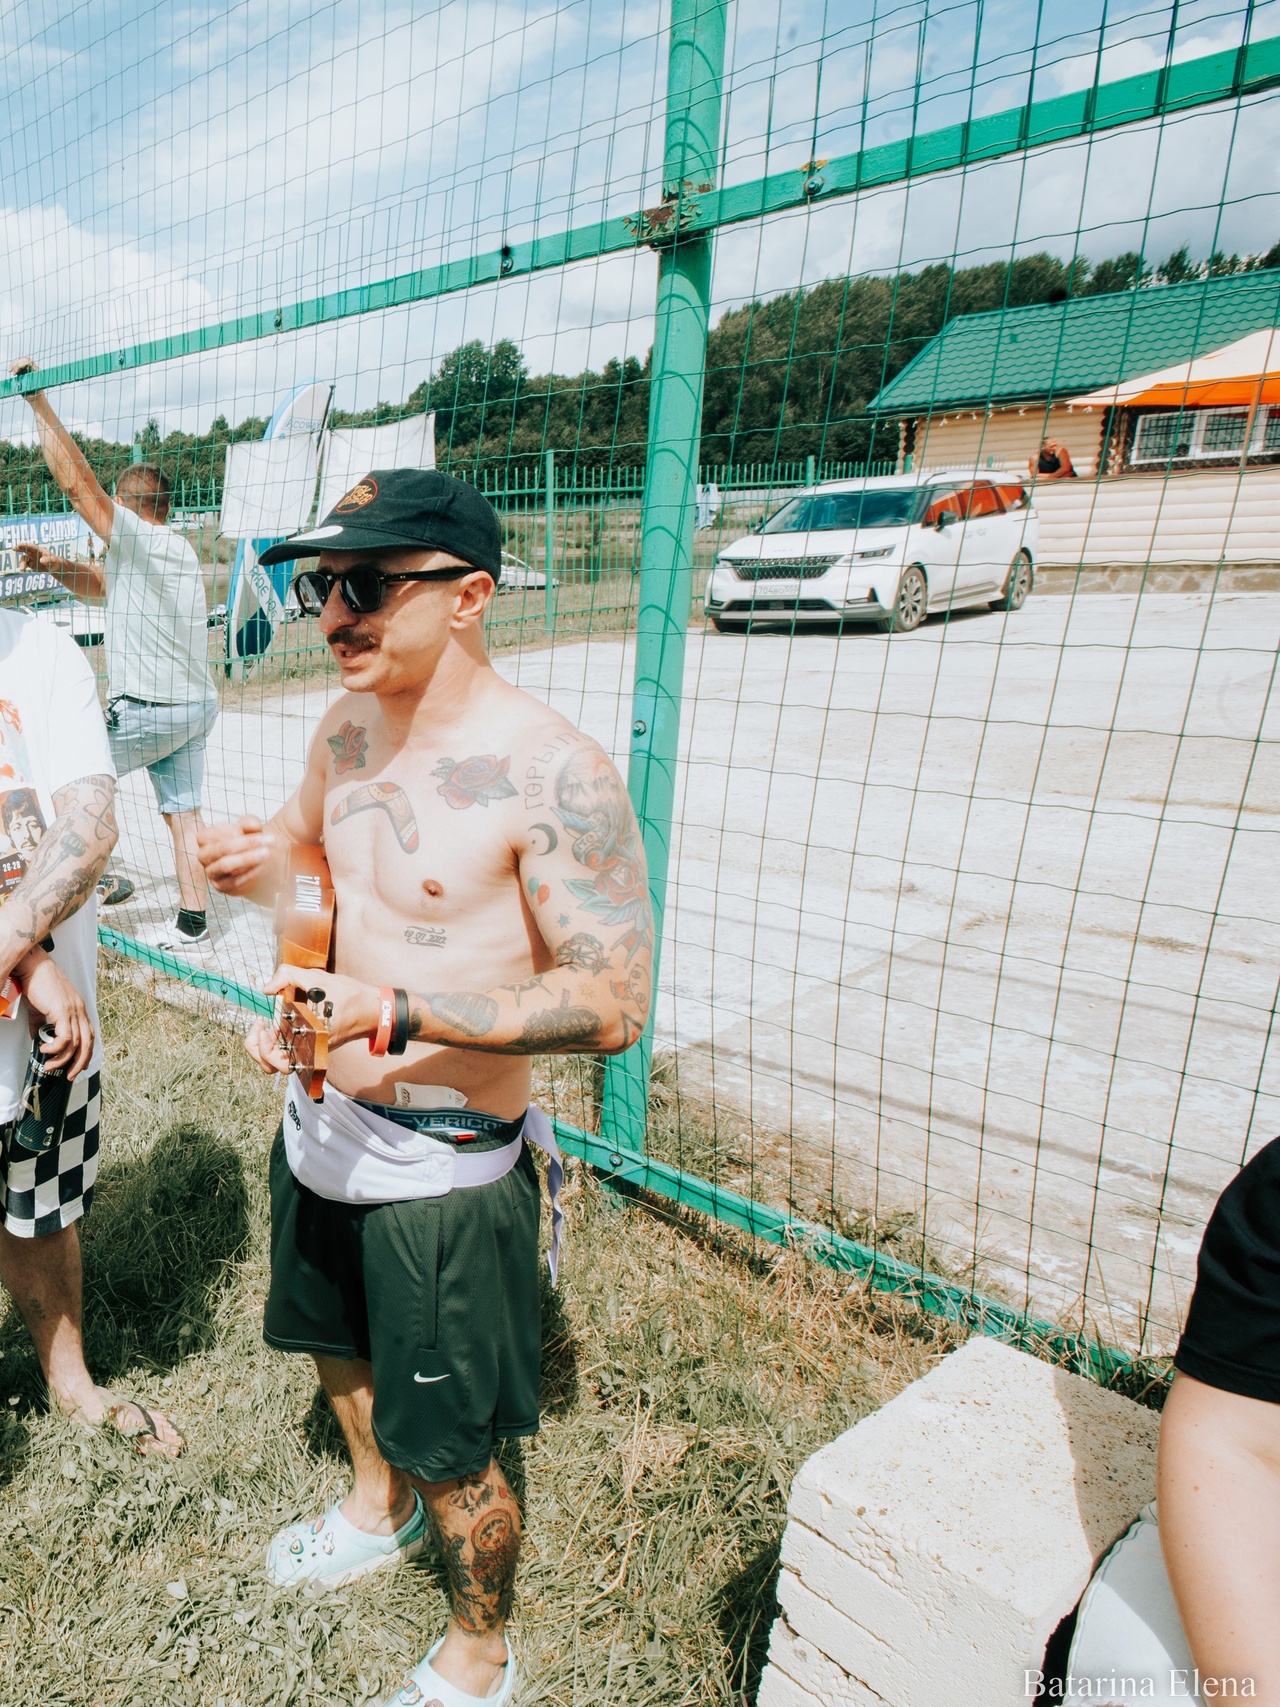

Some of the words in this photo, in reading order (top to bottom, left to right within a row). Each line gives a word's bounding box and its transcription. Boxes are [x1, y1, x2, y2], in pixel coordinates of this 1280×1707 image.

[40, 519, 78, 543] САПОВ
[5, 576, 24, 597] 919
[25, 573, 45, 592] 066
